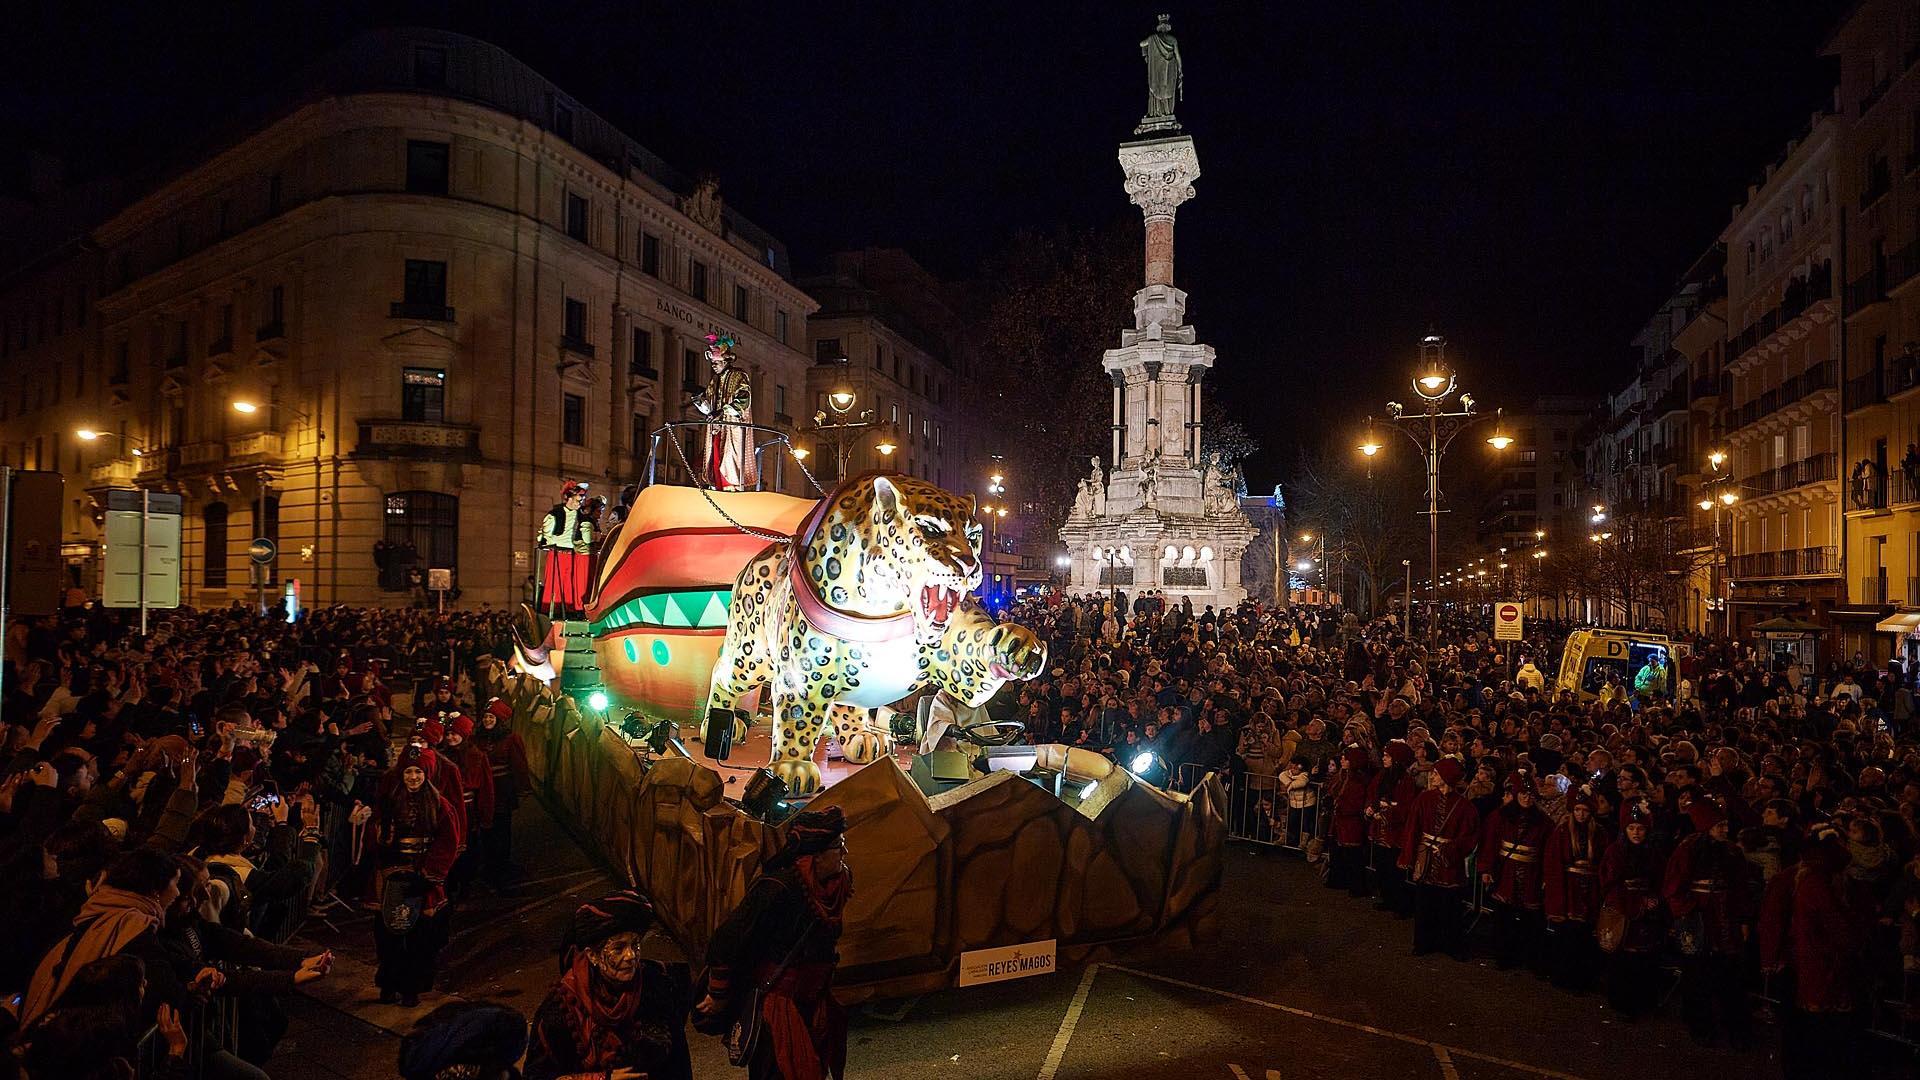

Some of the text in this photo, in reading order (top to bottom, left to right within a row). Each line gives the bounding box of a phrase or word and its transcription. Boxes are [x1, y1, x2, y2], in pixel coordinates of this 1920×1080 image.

[656, 298, 692, 324] BANCO
[988, 959, 1018, 976] REYES
[1019, 954, 1051, 971] MAGOS
